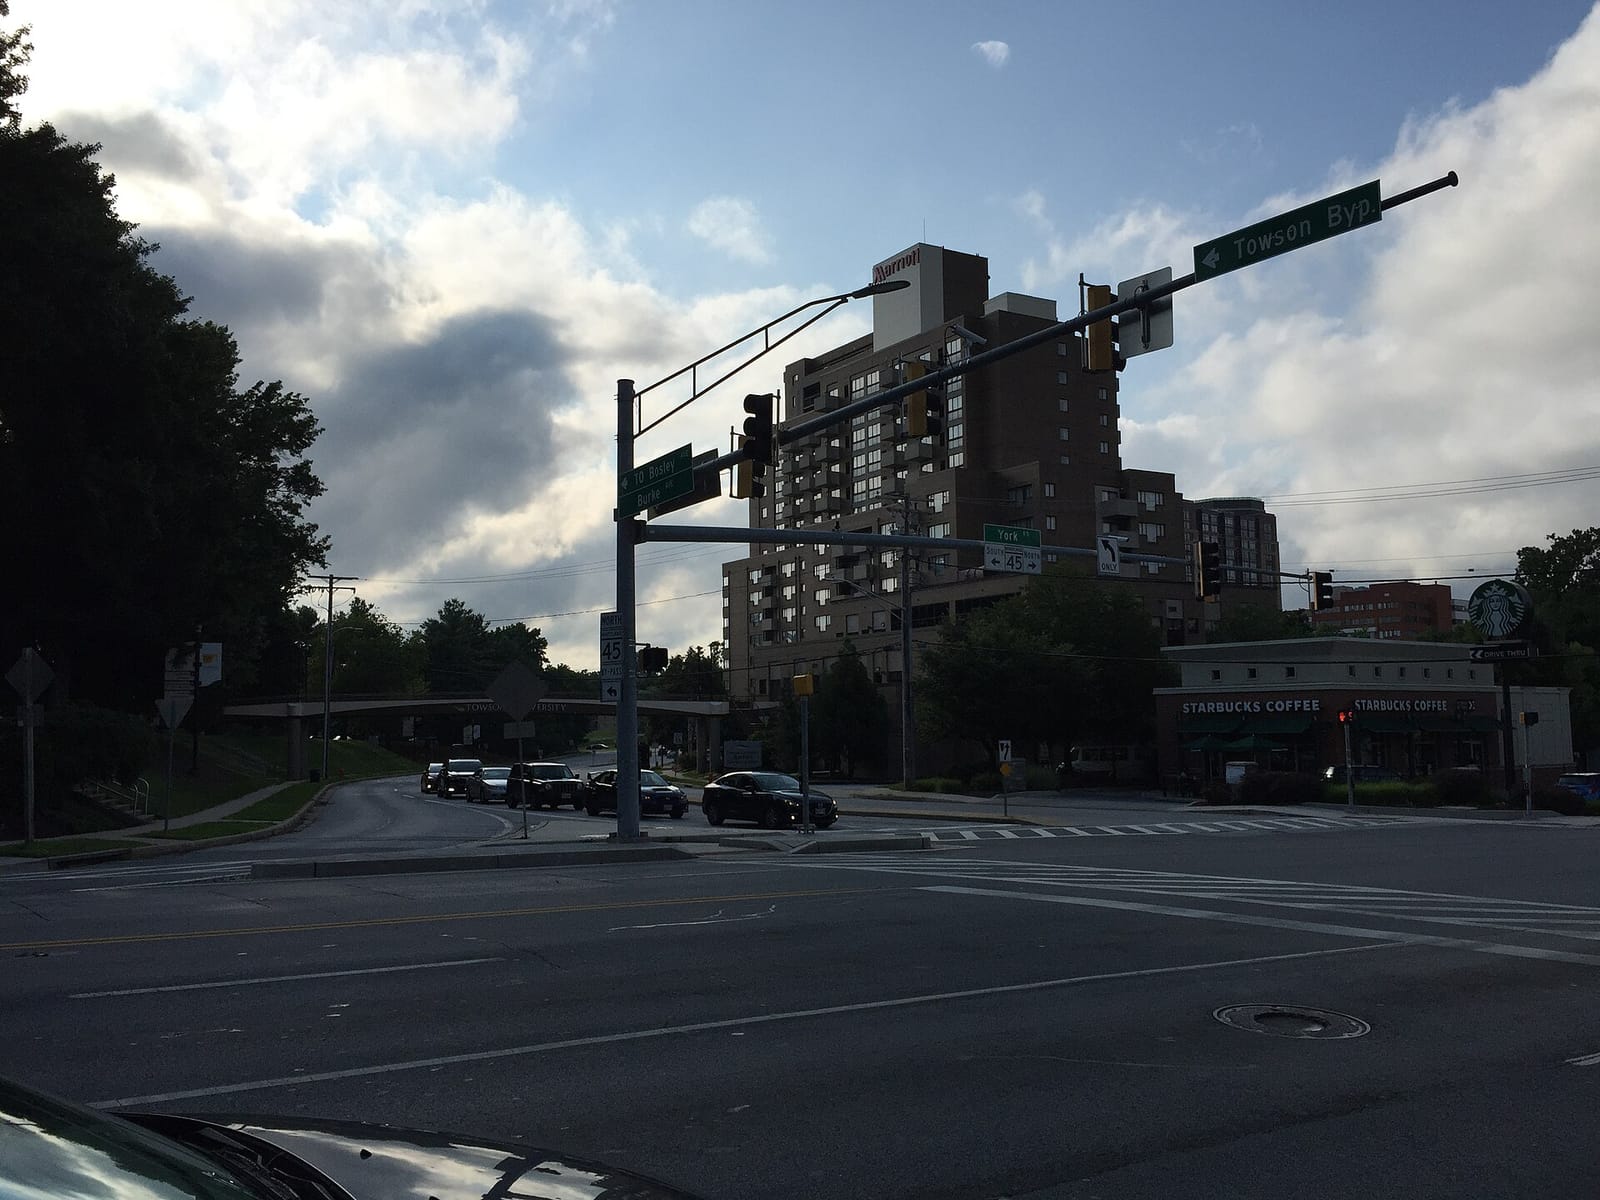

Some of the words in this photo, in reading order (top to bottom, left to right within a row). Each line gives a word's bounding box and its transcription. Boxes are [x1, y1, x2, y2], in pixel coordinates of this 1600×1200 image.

[1234, 218, 1311, 260] Towson
[874, 247, 920, 284] Marriott
[649, 459, 675, 480] Bosley
[637, 488, 660, 507] Burke
[998, 529, 1018, 542] York
[1006, 555, 1022, 570] 45
[1101, 562, 1117, 571] ONLY
[602, 641, 621, 660] 45
[1484, 649, 1504, 658] DRIVE
[530, 703, 567, 712] VERSITY
[1182, 701, 1261, 714] STARBUCKS
[1265, 699, 1320, 713] COFFEE
[1354, 699, 1411, 712] STARBUCKS
[1414, 700, 1448, 712] COFFEE
